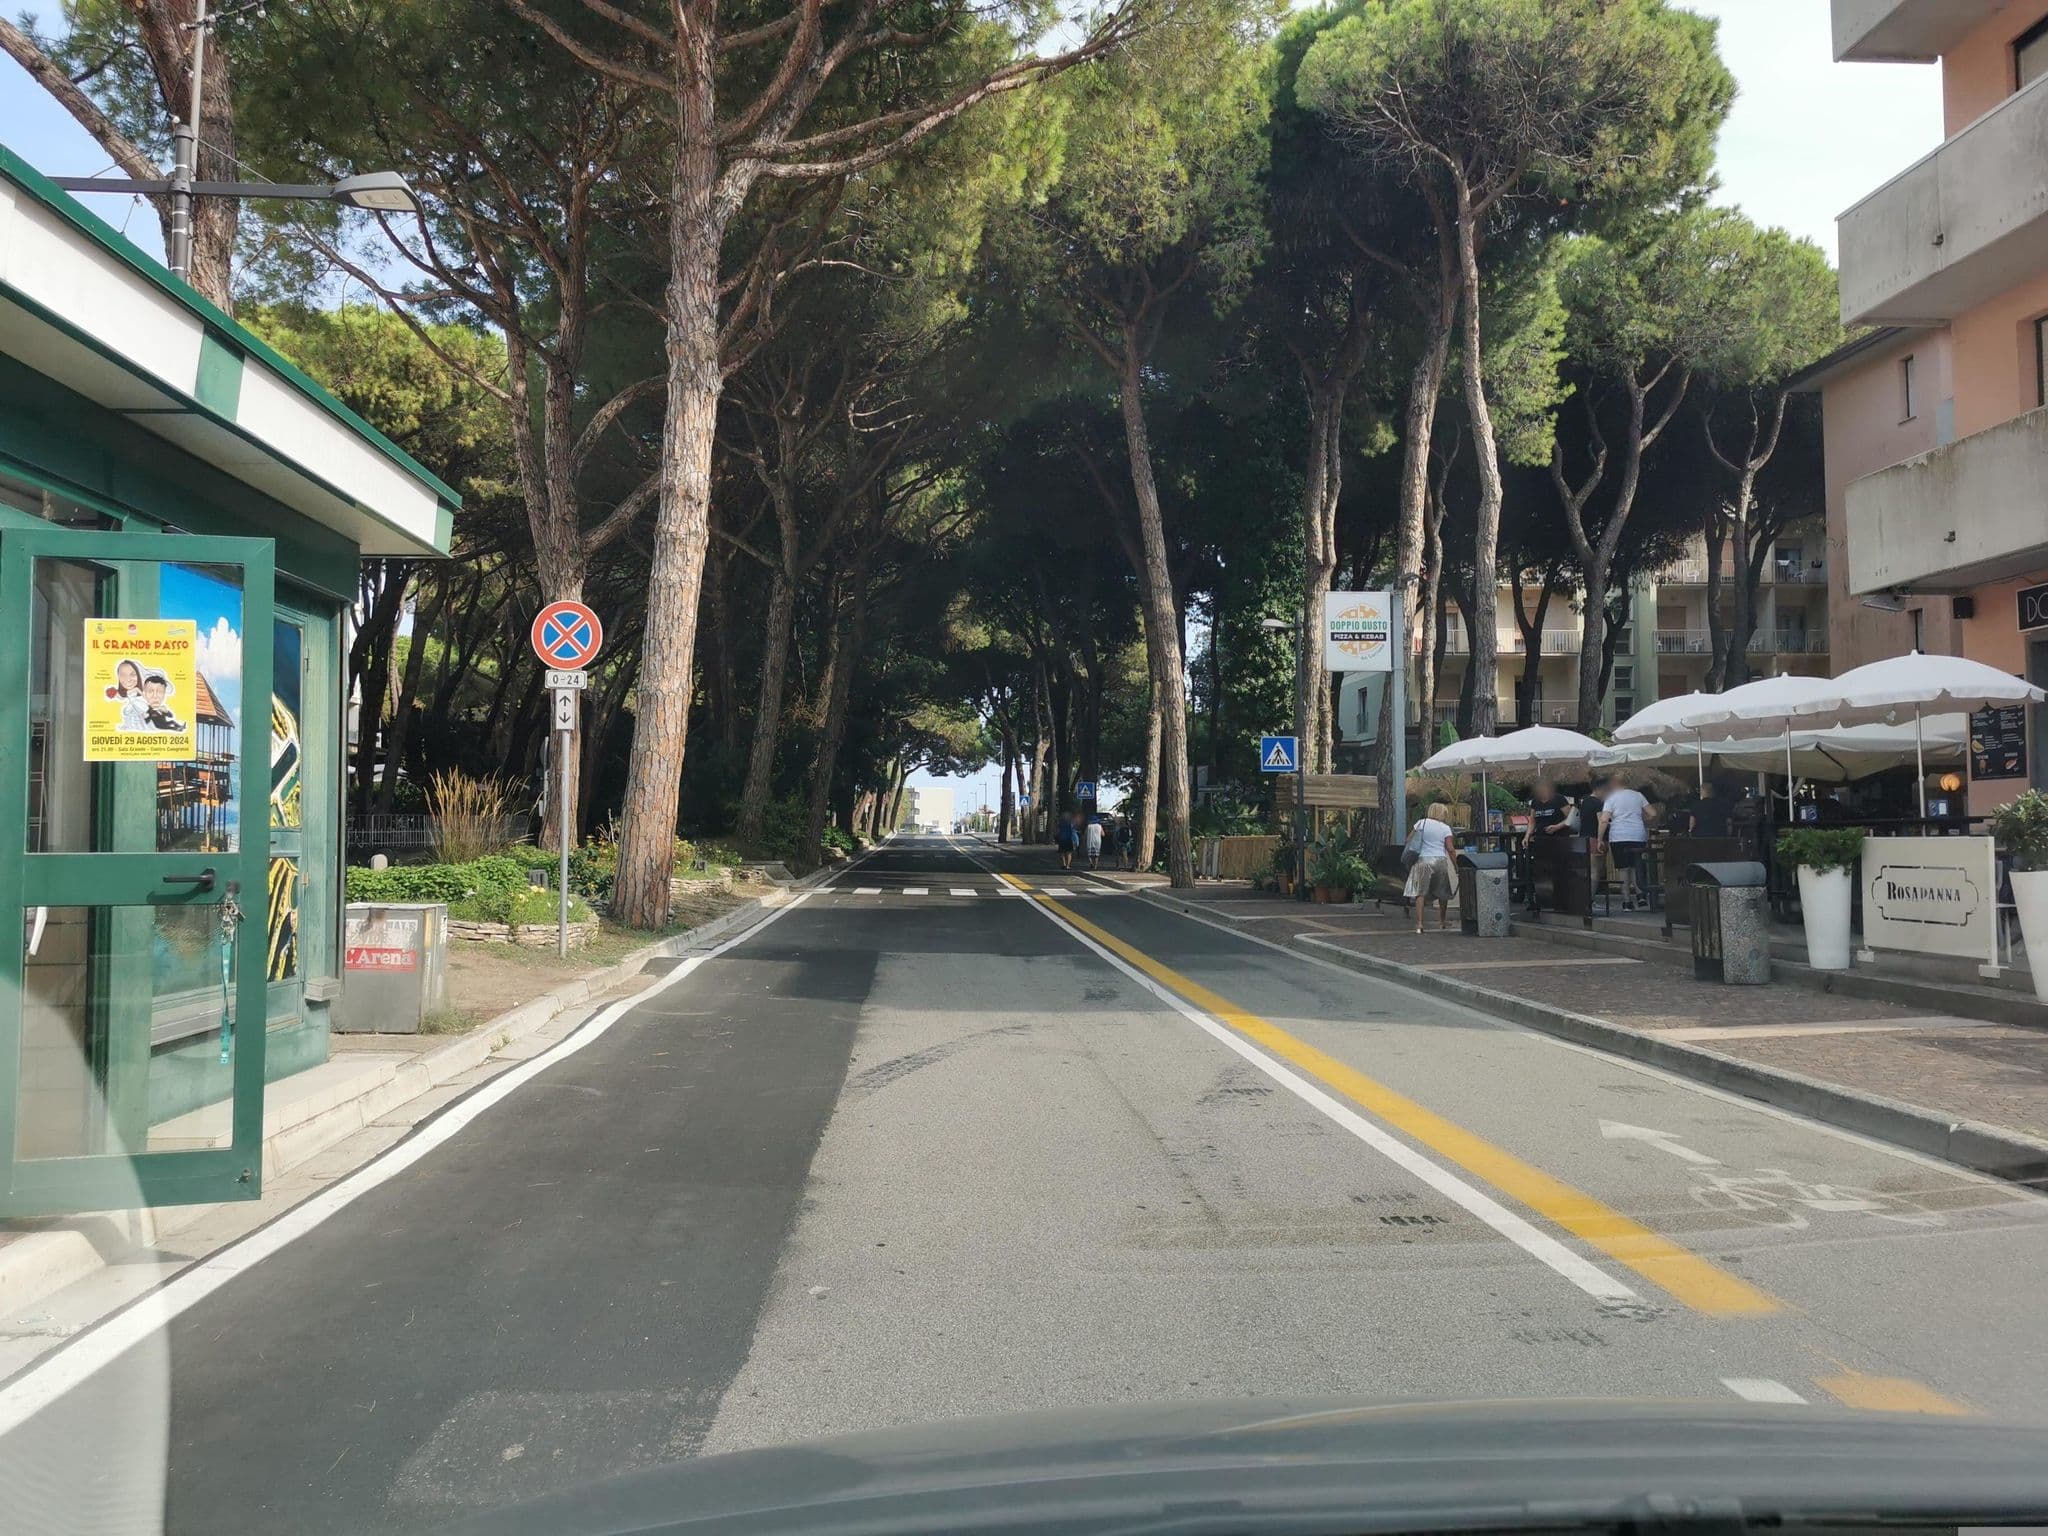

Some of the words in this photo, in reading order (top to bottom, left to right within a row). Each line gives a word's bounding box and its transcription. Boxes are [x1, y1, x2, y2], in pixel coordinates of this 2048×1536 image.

[1330, 620, 1360, 630] DOPPIO
[1361, 620, 1388, 630] GUSTO
[92, 639, 99, 649] IL
[103, 639, 151, 650] GRANDE
[154, 640, 189, 650] PASSO
[552, 674, 579, 685] 0-24
[91, 735, 122, 745] GIOVEDÌ
[125, 736, 135, 745] 29
[136, 736, 168, 745] AGOSTO
[169, 736, 189, 745] 2024
